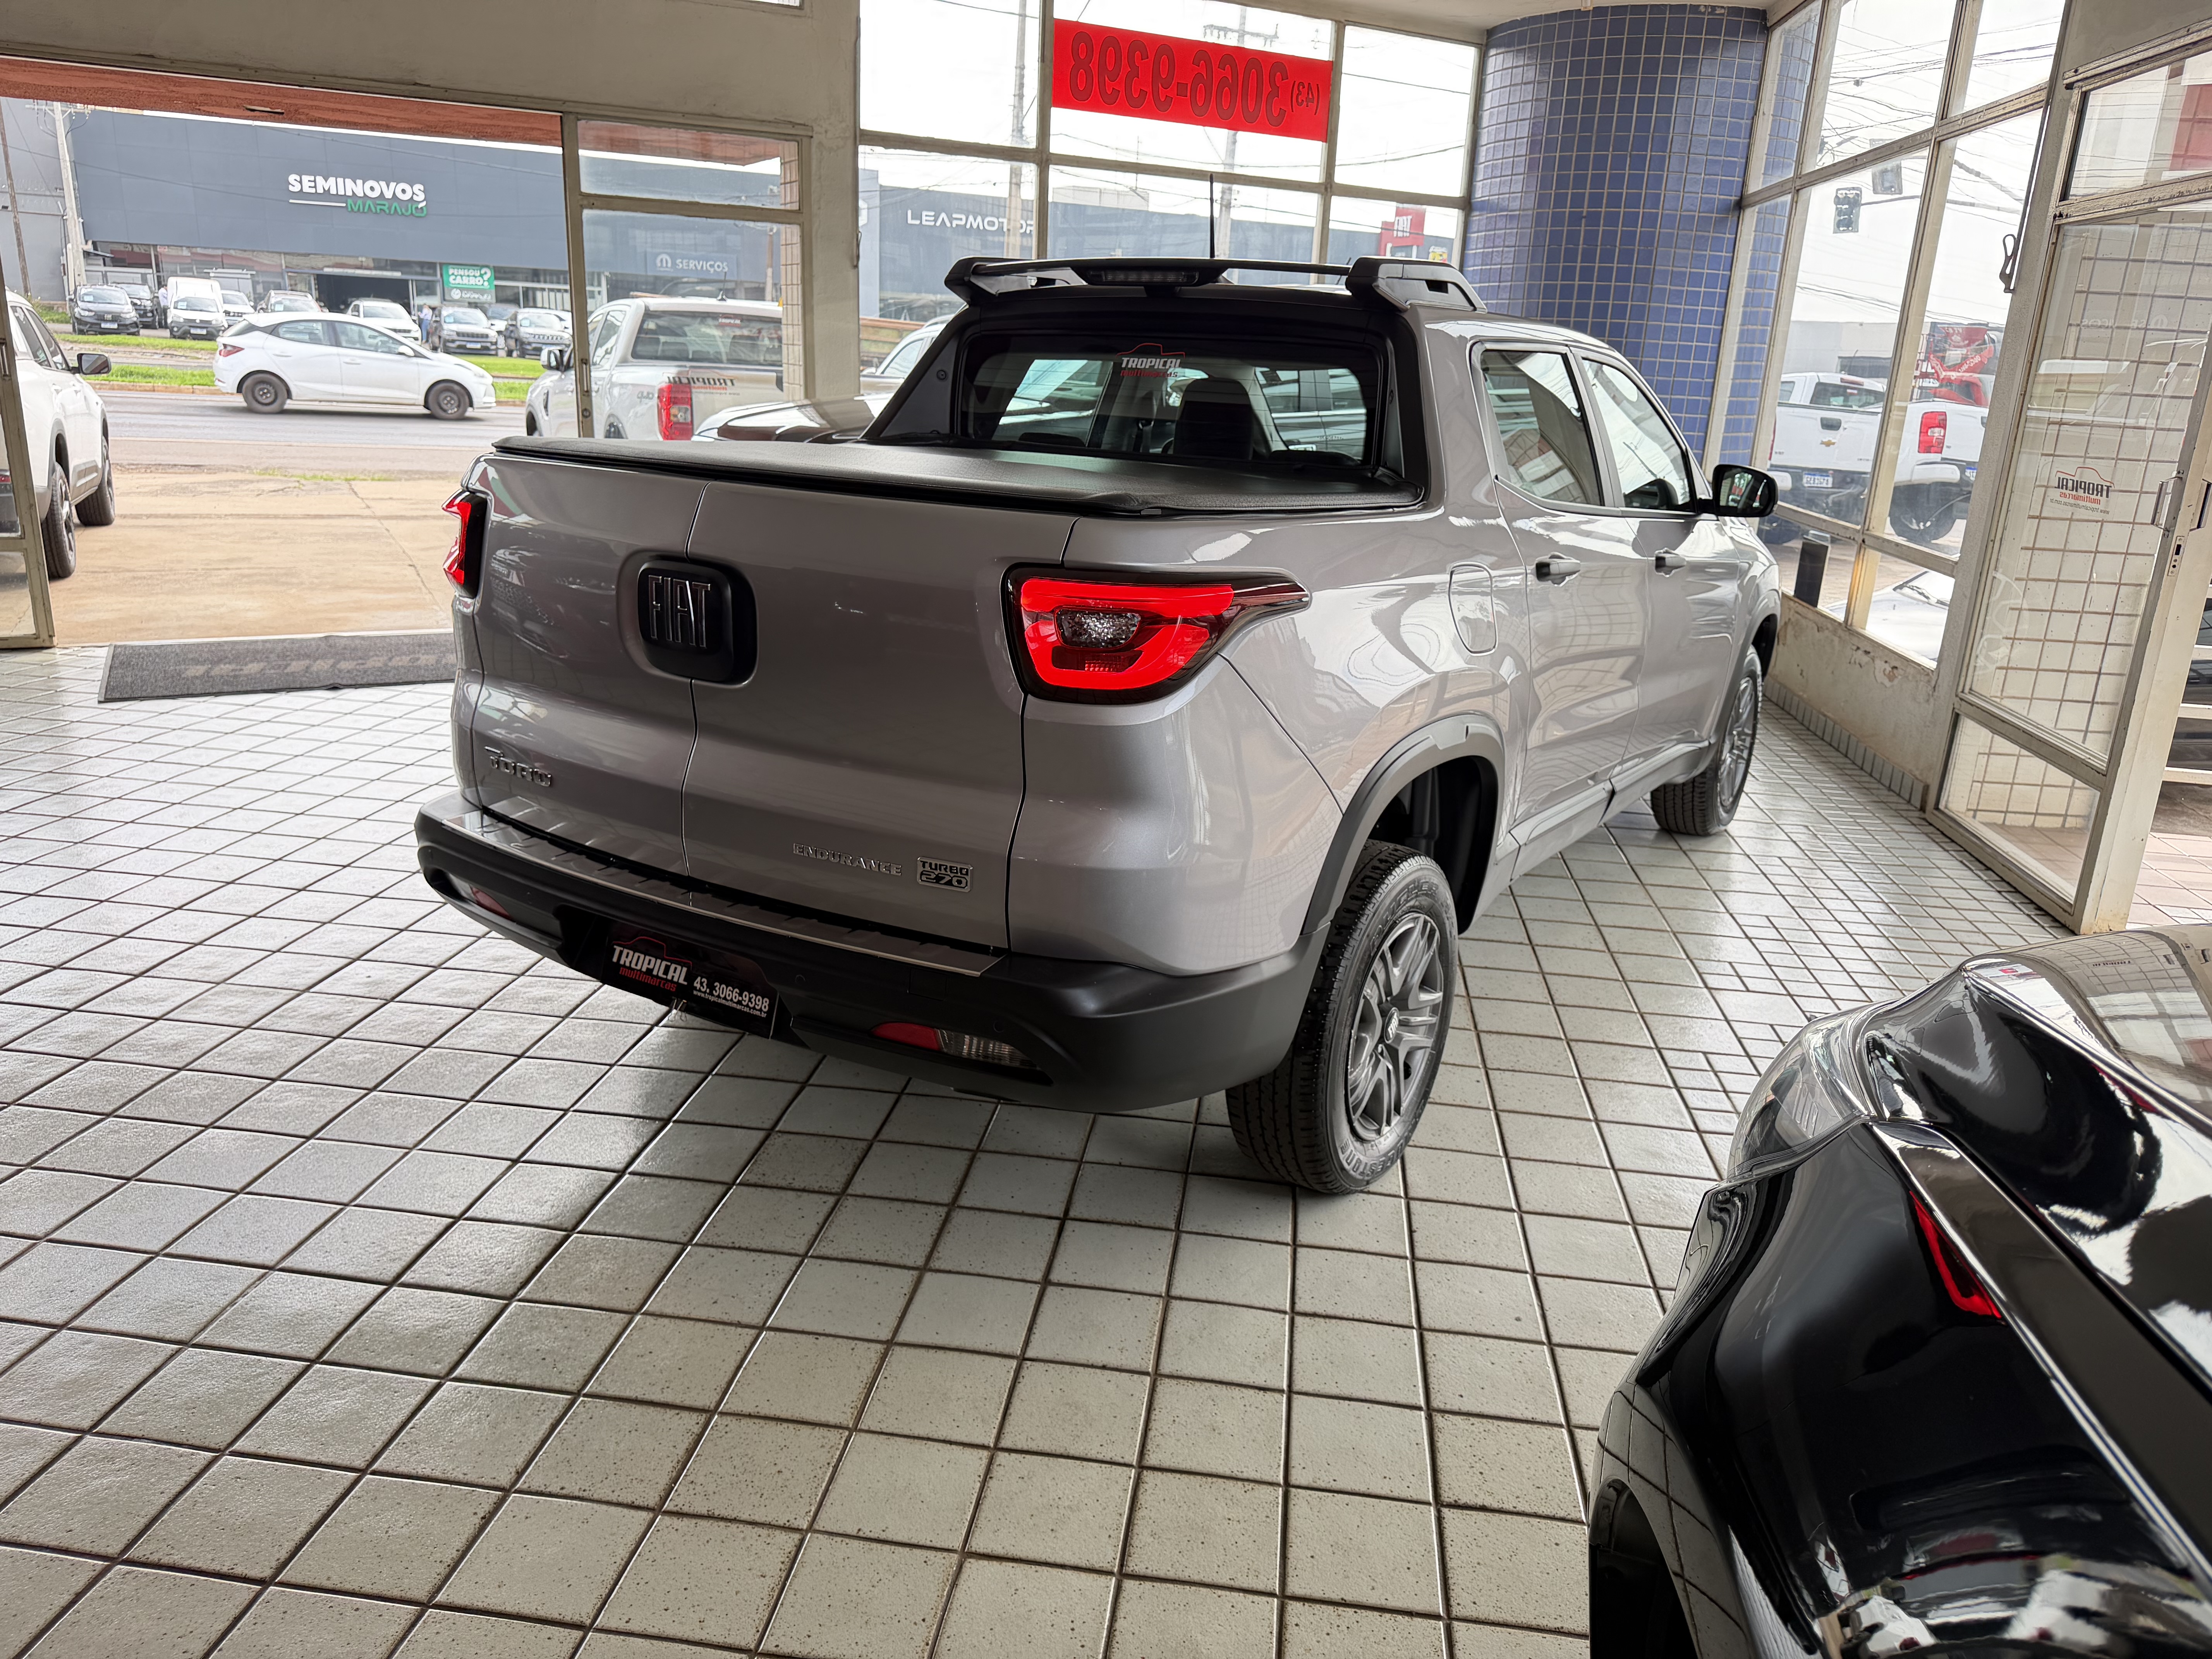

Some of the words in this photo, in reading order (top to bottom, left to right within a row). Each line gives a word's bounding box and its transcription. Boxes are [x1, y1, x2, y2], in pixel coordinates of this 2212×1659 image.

[289, 174, 425, 201] SEMINOVOS
[348, 199, 426, 217] MARAJÓ
[676, 259, 728, 273] SERVIÇOS
[1121, 357, 1181, 369] TROPICAL
[648, 575, 711, 649] FIAT
[484, 746, 551, 787] TORO
[793, 843, 902, 876] ENDURANCE
[920, 860, 969, 876] TURBO
[921, 871, 968, 889] 270
[612, 945, 687, 985] TROPICAL
[620, 967, 677, 992] multimarcas
[693, 990, 767, 1018] www.tropicalmultimarcas.com.br
[713, 982, 769, 1012] 3066-9398
